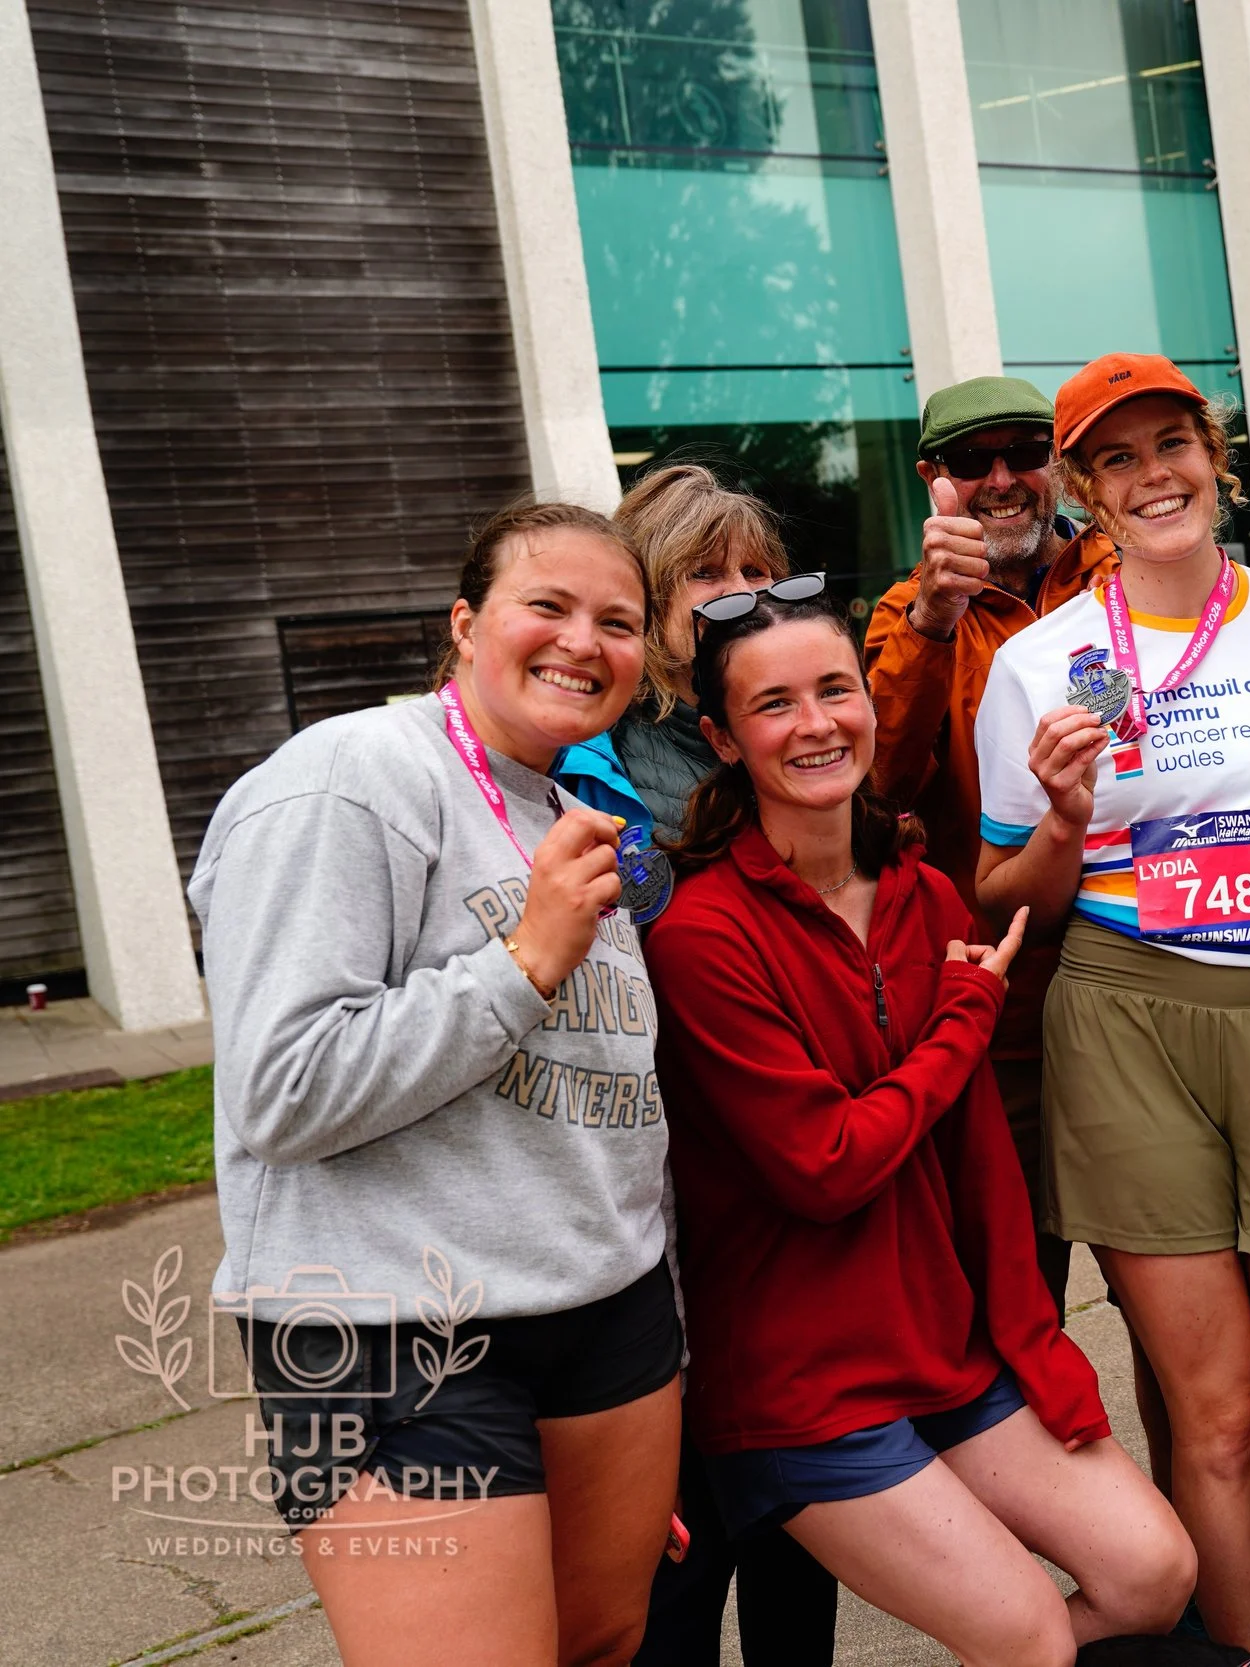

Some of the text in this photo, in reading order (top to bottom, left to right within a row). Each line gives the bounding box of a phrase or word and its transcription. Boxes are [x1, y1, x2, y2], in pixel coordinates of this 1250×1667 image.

[1108, 583, 1129, 655] Marathon 2026
[1181, 632, 1210, 671] Marathon
[1205, 602, 1222, 631] 2026
[1143, 678, 1241, 710] ymchwil
[1146, 703, 1220, 728] cymru
[1151, 725, 1230, 749] cancer
[448, 707, 480, 767] Marathon
[474, 769, 501, 805] 2026
[1155, 748, 1225, 773] wales
[1219, 828, 1239, 838] Half
[1138, 858, 1198, 881] LYDIA
